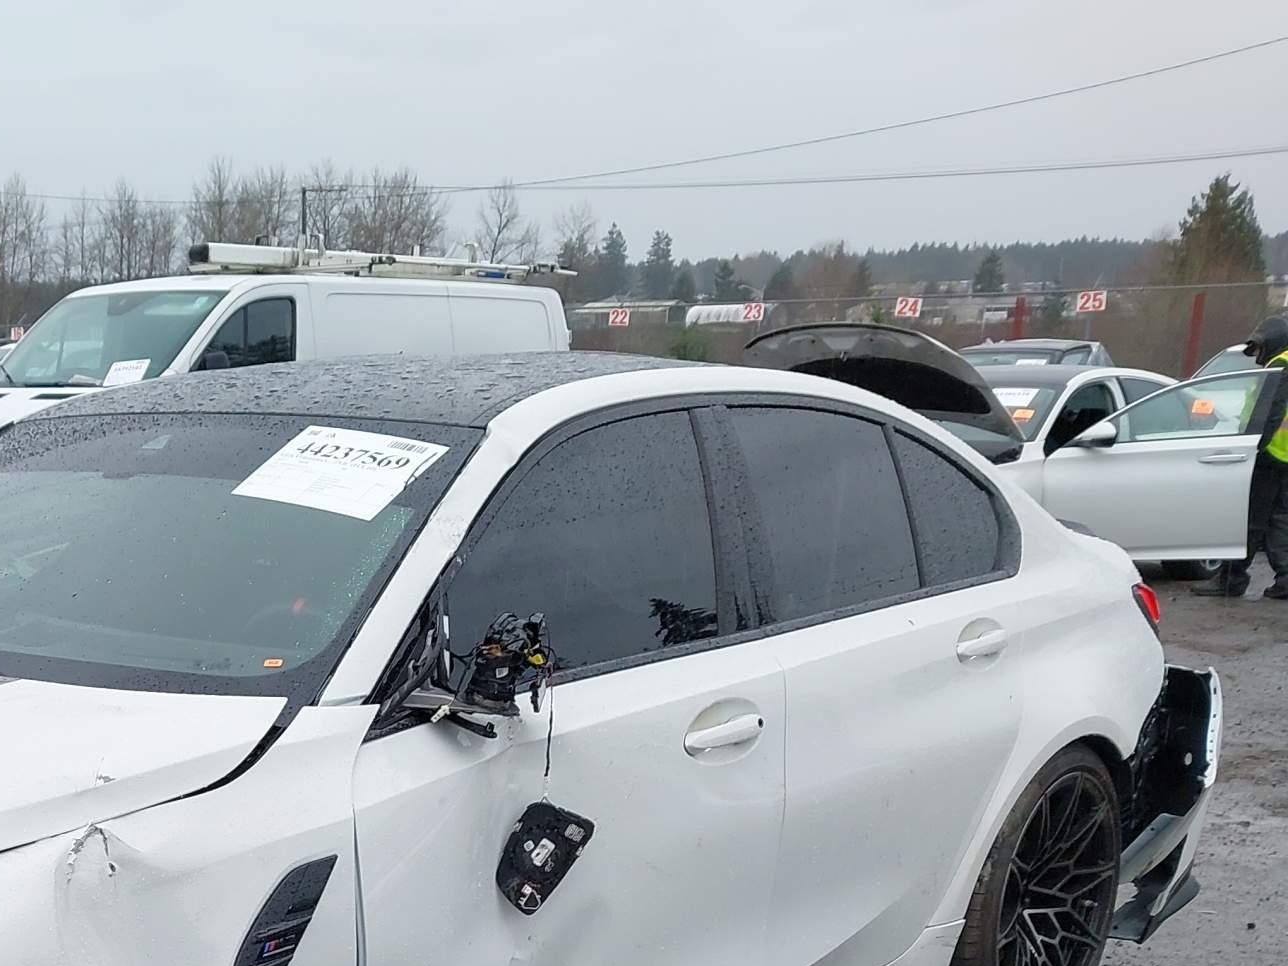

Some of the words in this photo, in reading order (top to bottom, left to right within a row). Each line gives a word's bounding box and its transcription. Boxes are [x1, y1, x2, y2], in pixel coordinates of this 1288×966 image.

[896, 298, 920, 317] 24
[1079, 292, 1105, 311] 25
[611, 309, 628, 324] 22
[743, 303, 762, 320] 23
[297, 441, 411, 470] 44237569
